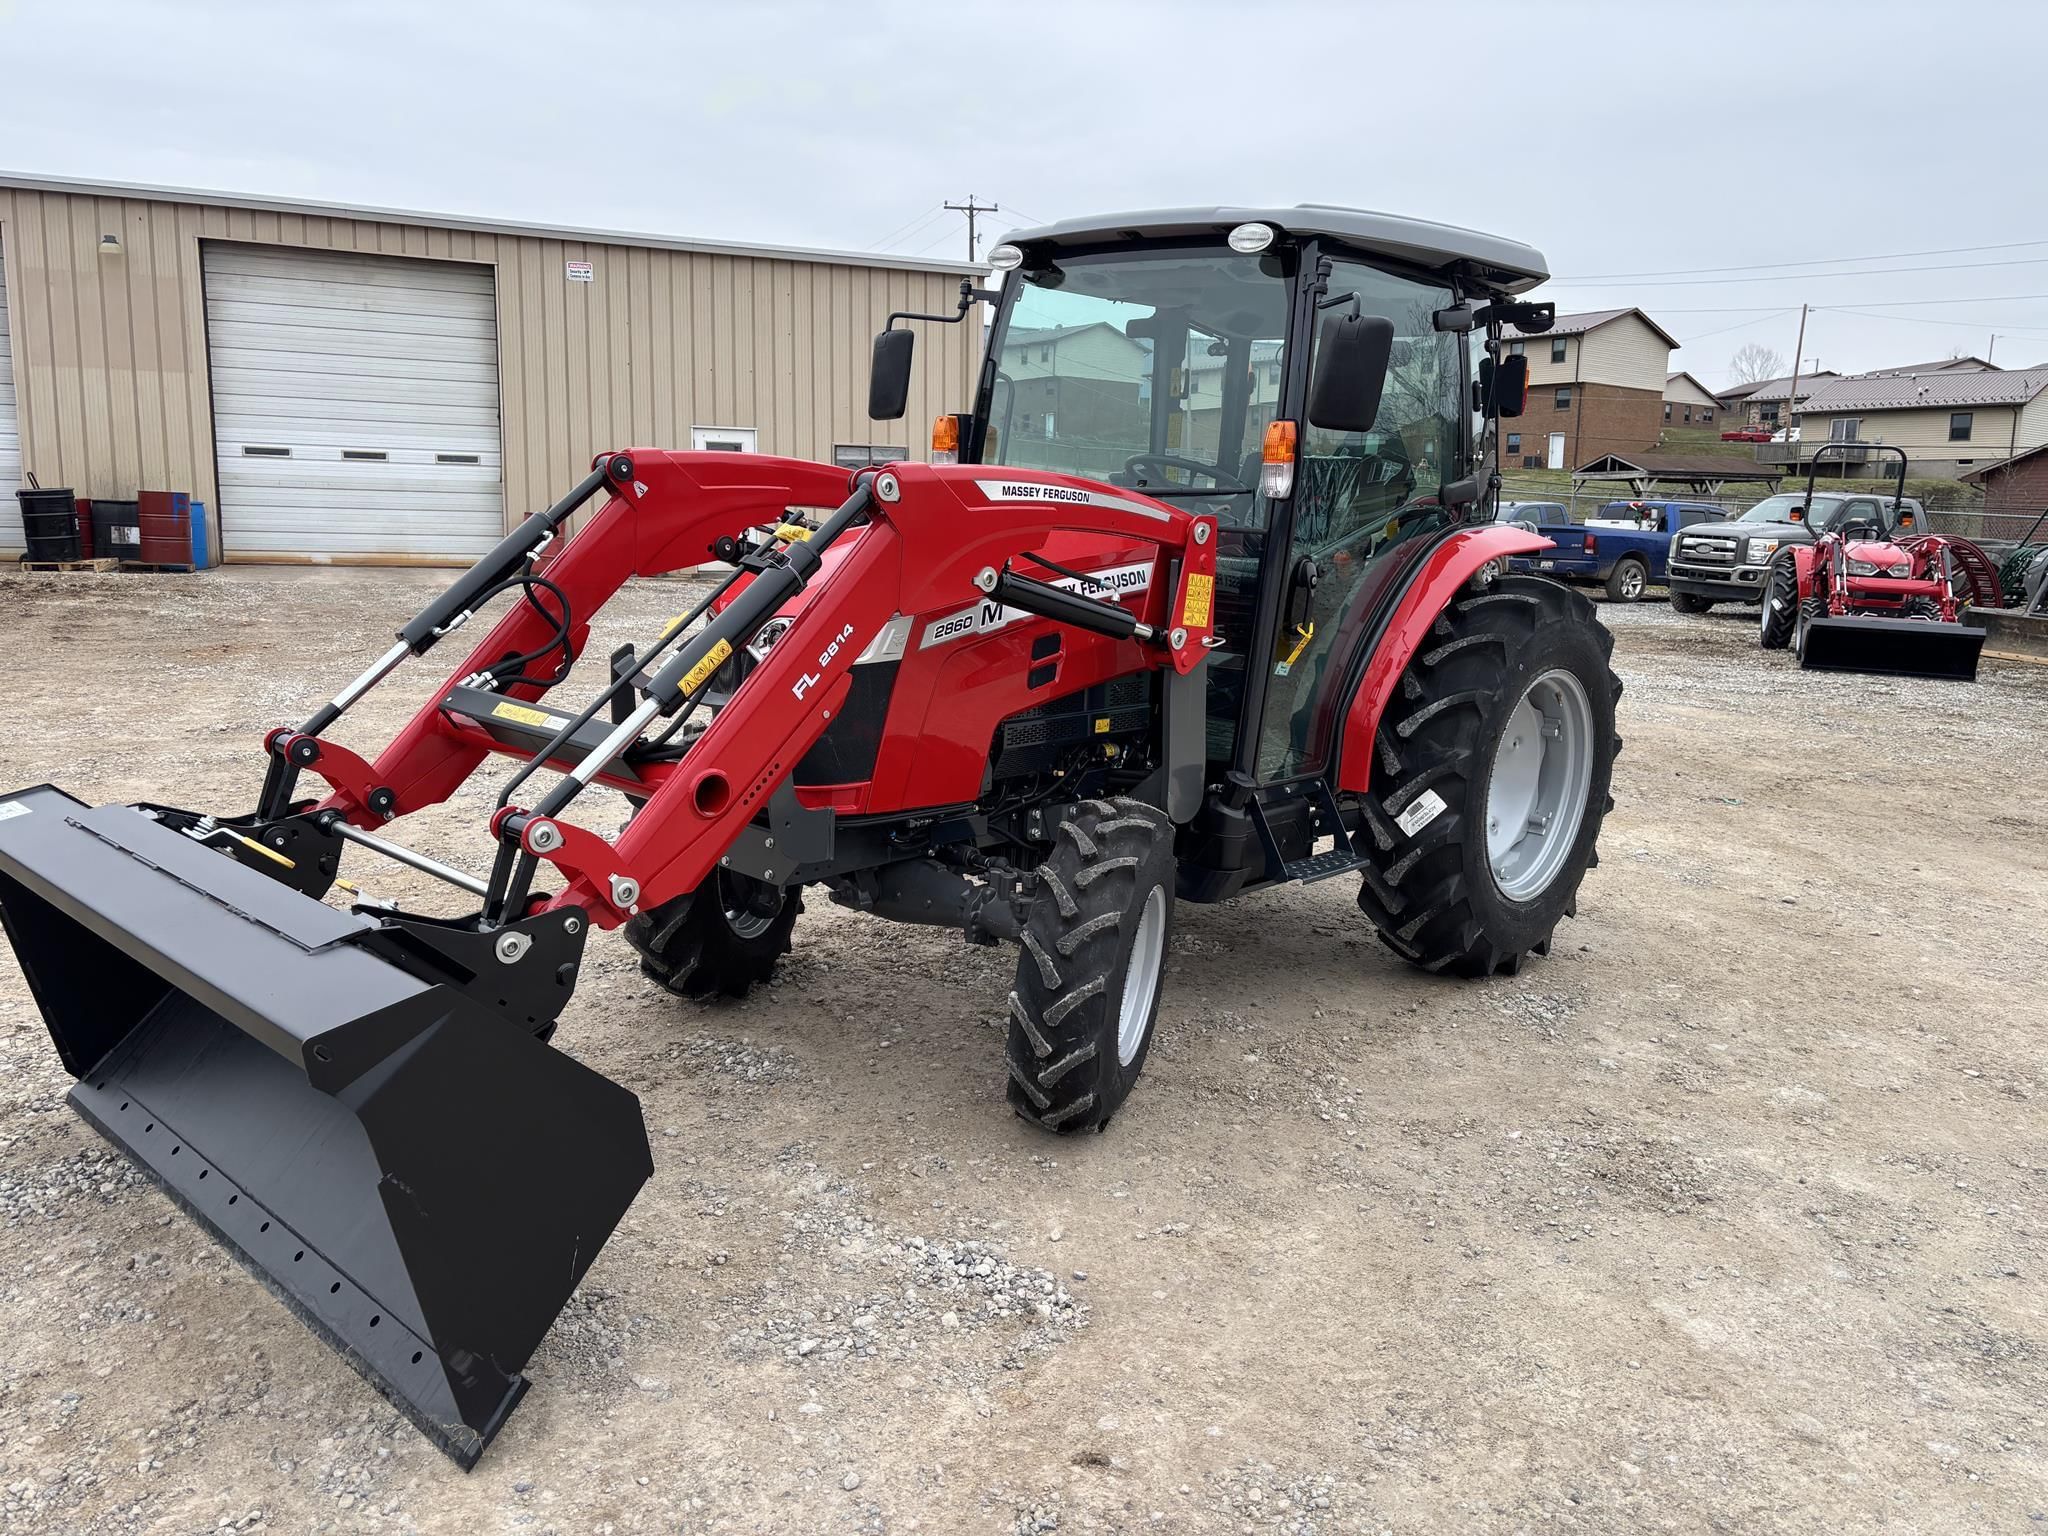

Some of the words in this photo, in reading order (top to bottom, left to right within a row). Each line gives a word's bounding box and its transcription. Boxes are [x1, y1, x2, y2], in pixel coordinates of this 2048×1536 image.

[1002, 485, 1041, 498] MASSEY
[1043, 487, 1090, 503] FERGUSON
[934, 615, 974, 639] 2860
[980, 602, 1004, 627] M
[791, 672, 821, 701] FL
[818, 623, 854, 668] 2814
